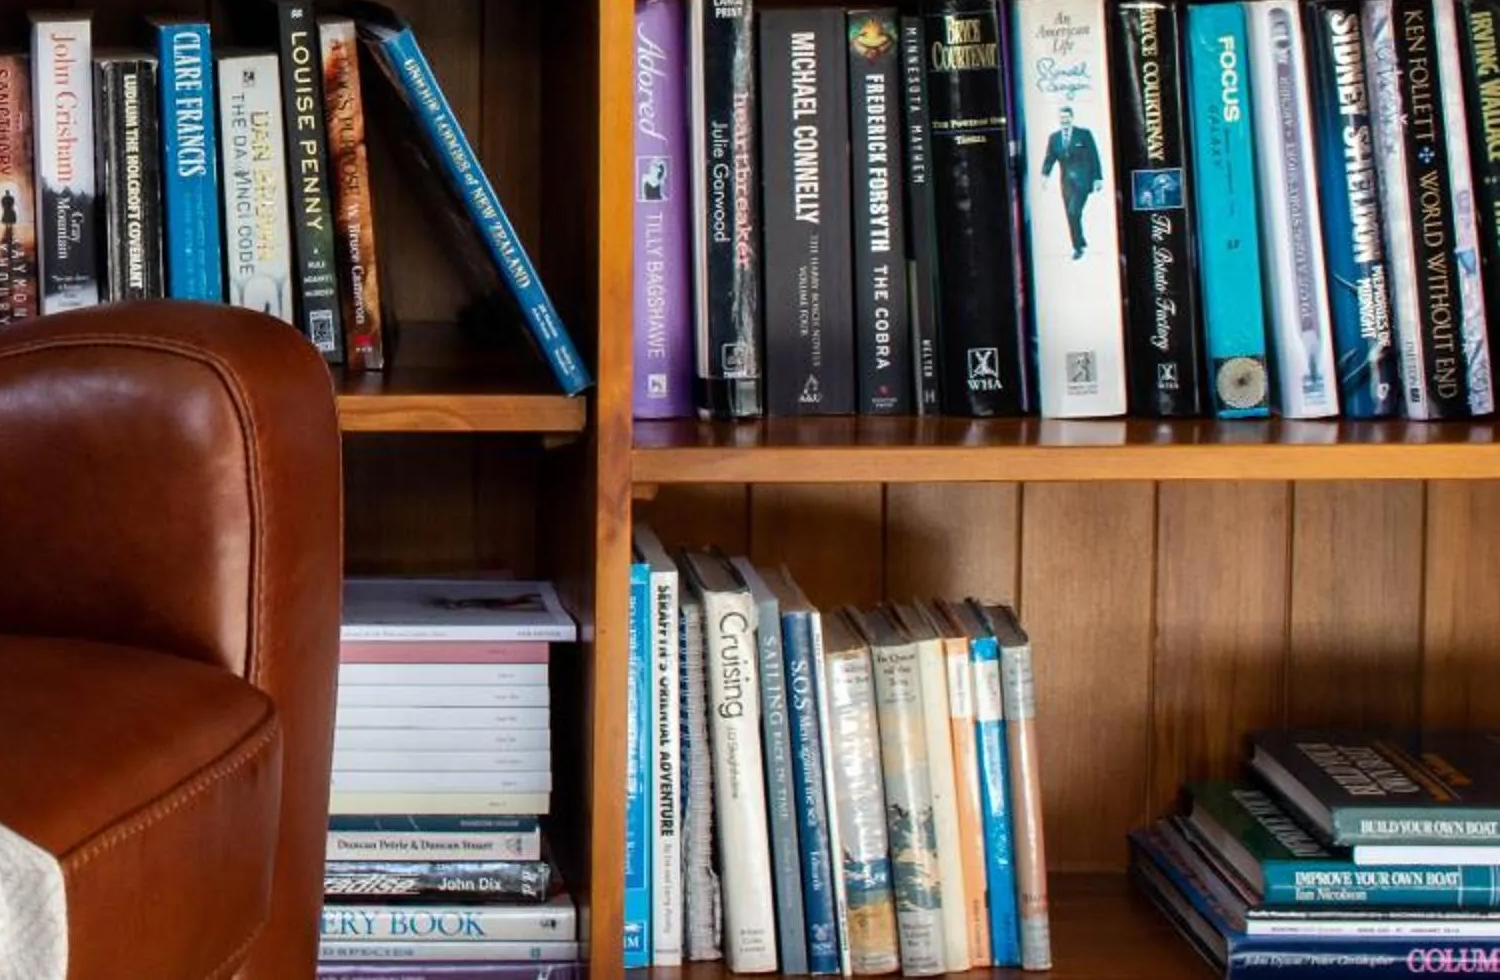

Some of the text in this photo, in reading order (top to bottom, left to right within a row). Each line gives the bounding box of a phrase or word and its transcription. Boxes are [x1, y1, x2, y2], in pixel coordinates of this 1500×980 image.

[172, 31, 201, 91] CLARE
[291, 31, 315, 131] LOUISE
[905, 27, 924, 184] MINNESOTA MAYHEM
[1218, 34, 1240, 122] FOCUS
[49, 32, 81, 183] John Grisham
[175, 96, 206, 178] FRANCIS
[790, 32, 820, 224] MICHAEL CONNELLY
[1327, 11, 1381, 263] SIDNEY SHELDON
[124, 74, 143, 290] LUDLUM THE HOLCROFT COVENANT
[298, 139, 323, 232] PENNY
[638, 24, 668, 359] Adored TILLY BAGSHAWE
[711, 119, 730, 242] Julie Garwood
[733, 91, 753, 269] heartbreaker
[866, 74, 890, 369] FREDERICK FORSYTH THE COBRA
[1139, 2, 1175, 350] BRYCE COURTENAY The Potato Factory
[1403, 9, 1458, 399] KEN FOLLETT WORLD WITHOUT END
[57, 196, 73, 260] Mountain
[66, 210, 84, 243] Gray
[718, 612, 752, 719] Cruising
[763, 635, 783, 726] SAILING
[791, 659, 811, 711] S.O.S
[659, 750, 675, 837] ADVENTURE
[1360, 820, 1498, 837] BUILD YOUR OWN BOAT
[320, 910, 486, 938] ERY BOOK
[438, 877, 501, 891] John Dix
[1294, 871, 1460, 887] IMPROVE YOUR OWN BOAT
[1294, 888, 1316, 901] Ian
[1406, 947, 1500, 974] COLUM
